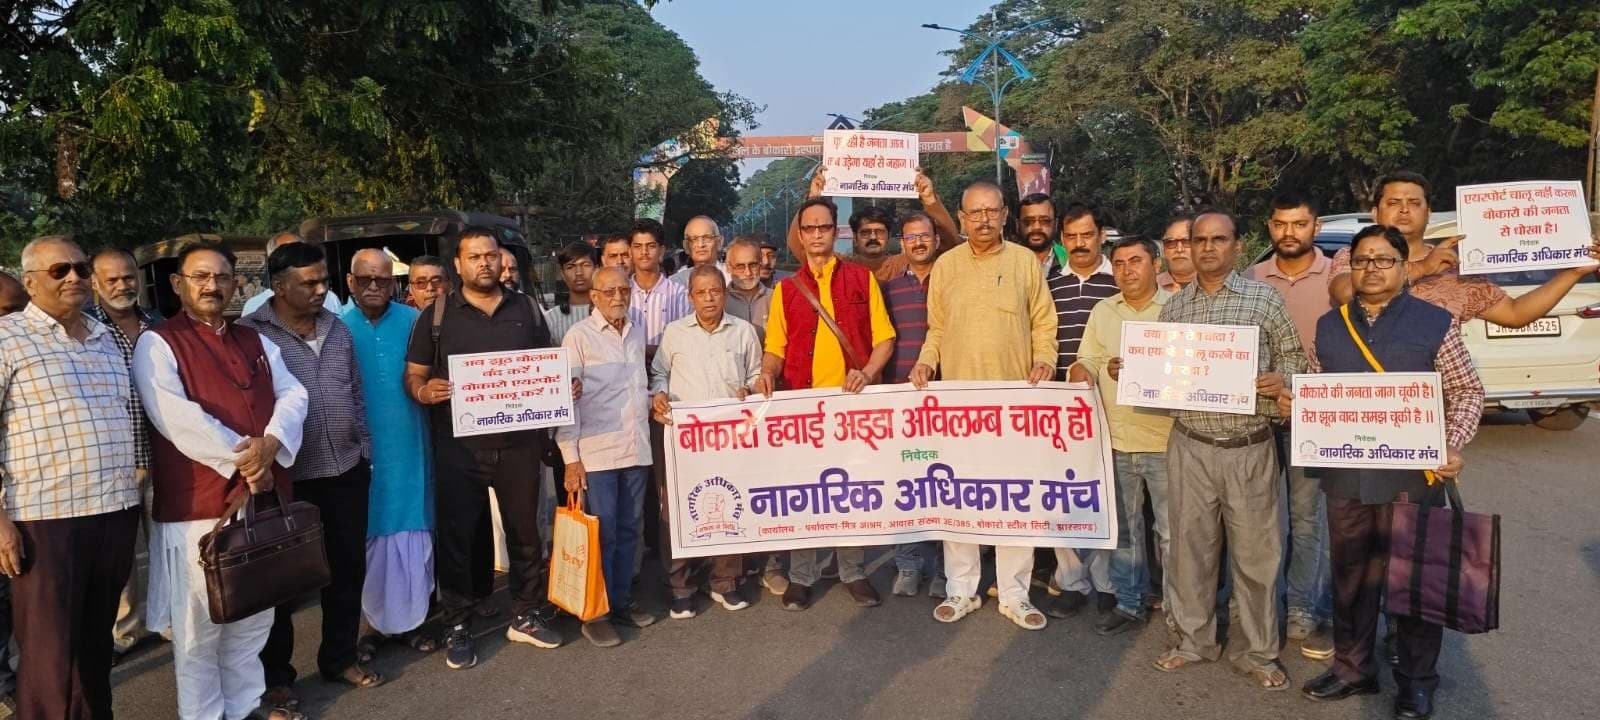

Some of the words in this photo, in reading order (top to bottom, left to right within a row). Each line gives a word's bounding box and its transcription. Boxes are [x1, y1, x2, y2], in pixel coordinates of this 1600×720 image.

[866, 138, 887, 149] जनता
[839, 180, 869, 191] नागरिक
[871, 180, 900, 191] अधिकार
[1464, 188, 1507, 204] एयरपोर्ट
[1509, 189, 1533, 202] चालू
[1482, 205, 1521, 220] बोकारो
[1523, 204, 1538, 218] की
[1541, 205, 1570, 217] जनता
[1500, 224, 1510, 237] से
[1513, 223, 1542, 236] धोखा
[1486, 248, 1528, 264] नागरिक
[1531, 246, 1572, 262] अधिकार
[1235, 351, 1249, 361] का
[511, 375, 562, 386] एयरपोर्ट
[1186, 389, 1229, 405] अधिकार
[1330, 383, 1343, 399] की
[1345, 385, 1372, 399] जनता
[1374, 386, 1396, 399] जाग
[1398, 382, 1420, 402] चूकी
[476, 411, 514, 426] नागरिक
[516, 408, 552, 421] अधिकार
[554, 406, 569, 418] मंच
[678, 409, 759, 453] बोकारो
[764, 401, 826, 448] हवाई
[833, 408, 895, 451] अड्डा
[901, 395, 1003, 439] अविलम्ब
[1009, 405, 1068, 452] चालू
[1065, 396, 1094, 441] हो
[1301, 408, 1318, 424] तेरा
[1318, 410, 1337, 427] झूठा
[1339, 410, 1358, 424] वादा
[1361, 410, 1387, 424] समझ
[1389, 407, 1411, 428] चूकी
[1413, 408, 1422, 424] है
[900, 449, 939, 462] निवेदक
[1319, 443, 1364, 459] नागरिक
[1367, 444, 1416, 460] अधिकार
[1418, 445, 1439, 460] मंच
[748, 467, 885, 518] नागरिक
[894, 462, 1034, 513] अधिकार
[1039, 468, 1101, 514] मंच
[889, 519, 914, 528] आवास
